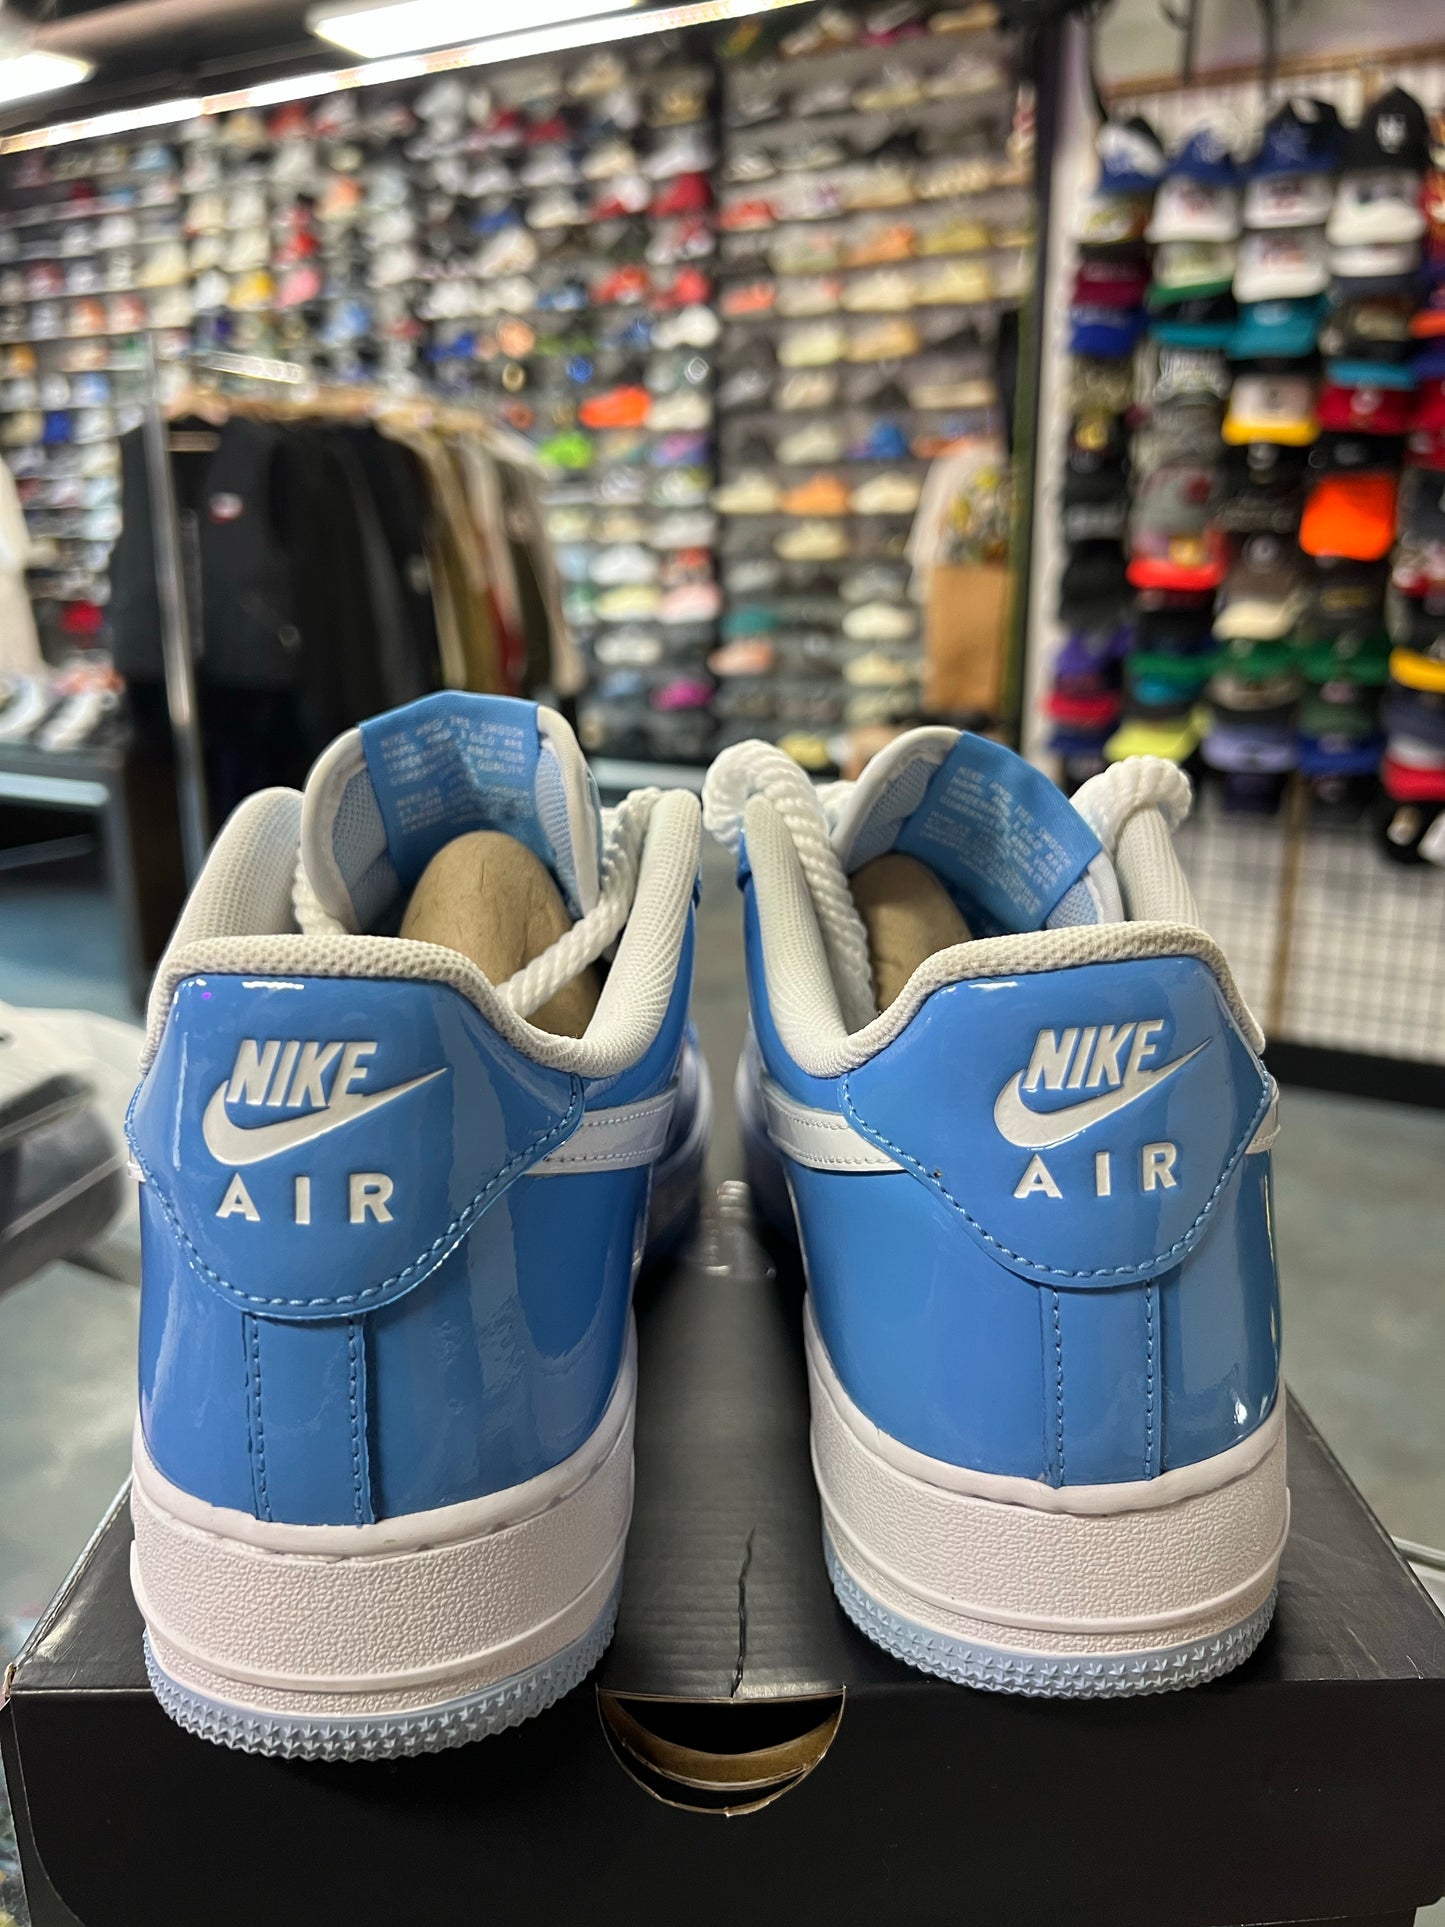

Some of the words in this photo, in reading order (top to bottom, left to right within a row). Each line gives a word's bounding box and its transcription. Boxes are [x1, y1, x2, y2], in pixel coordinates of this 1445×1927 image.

[225, 1039, 378, 1108] NIKE
[1021, 1018, 1164, 1090] NIKE
[215, 1172, 394, 1225] AIR
[1013, 1142, 1177, 1199] AIR
